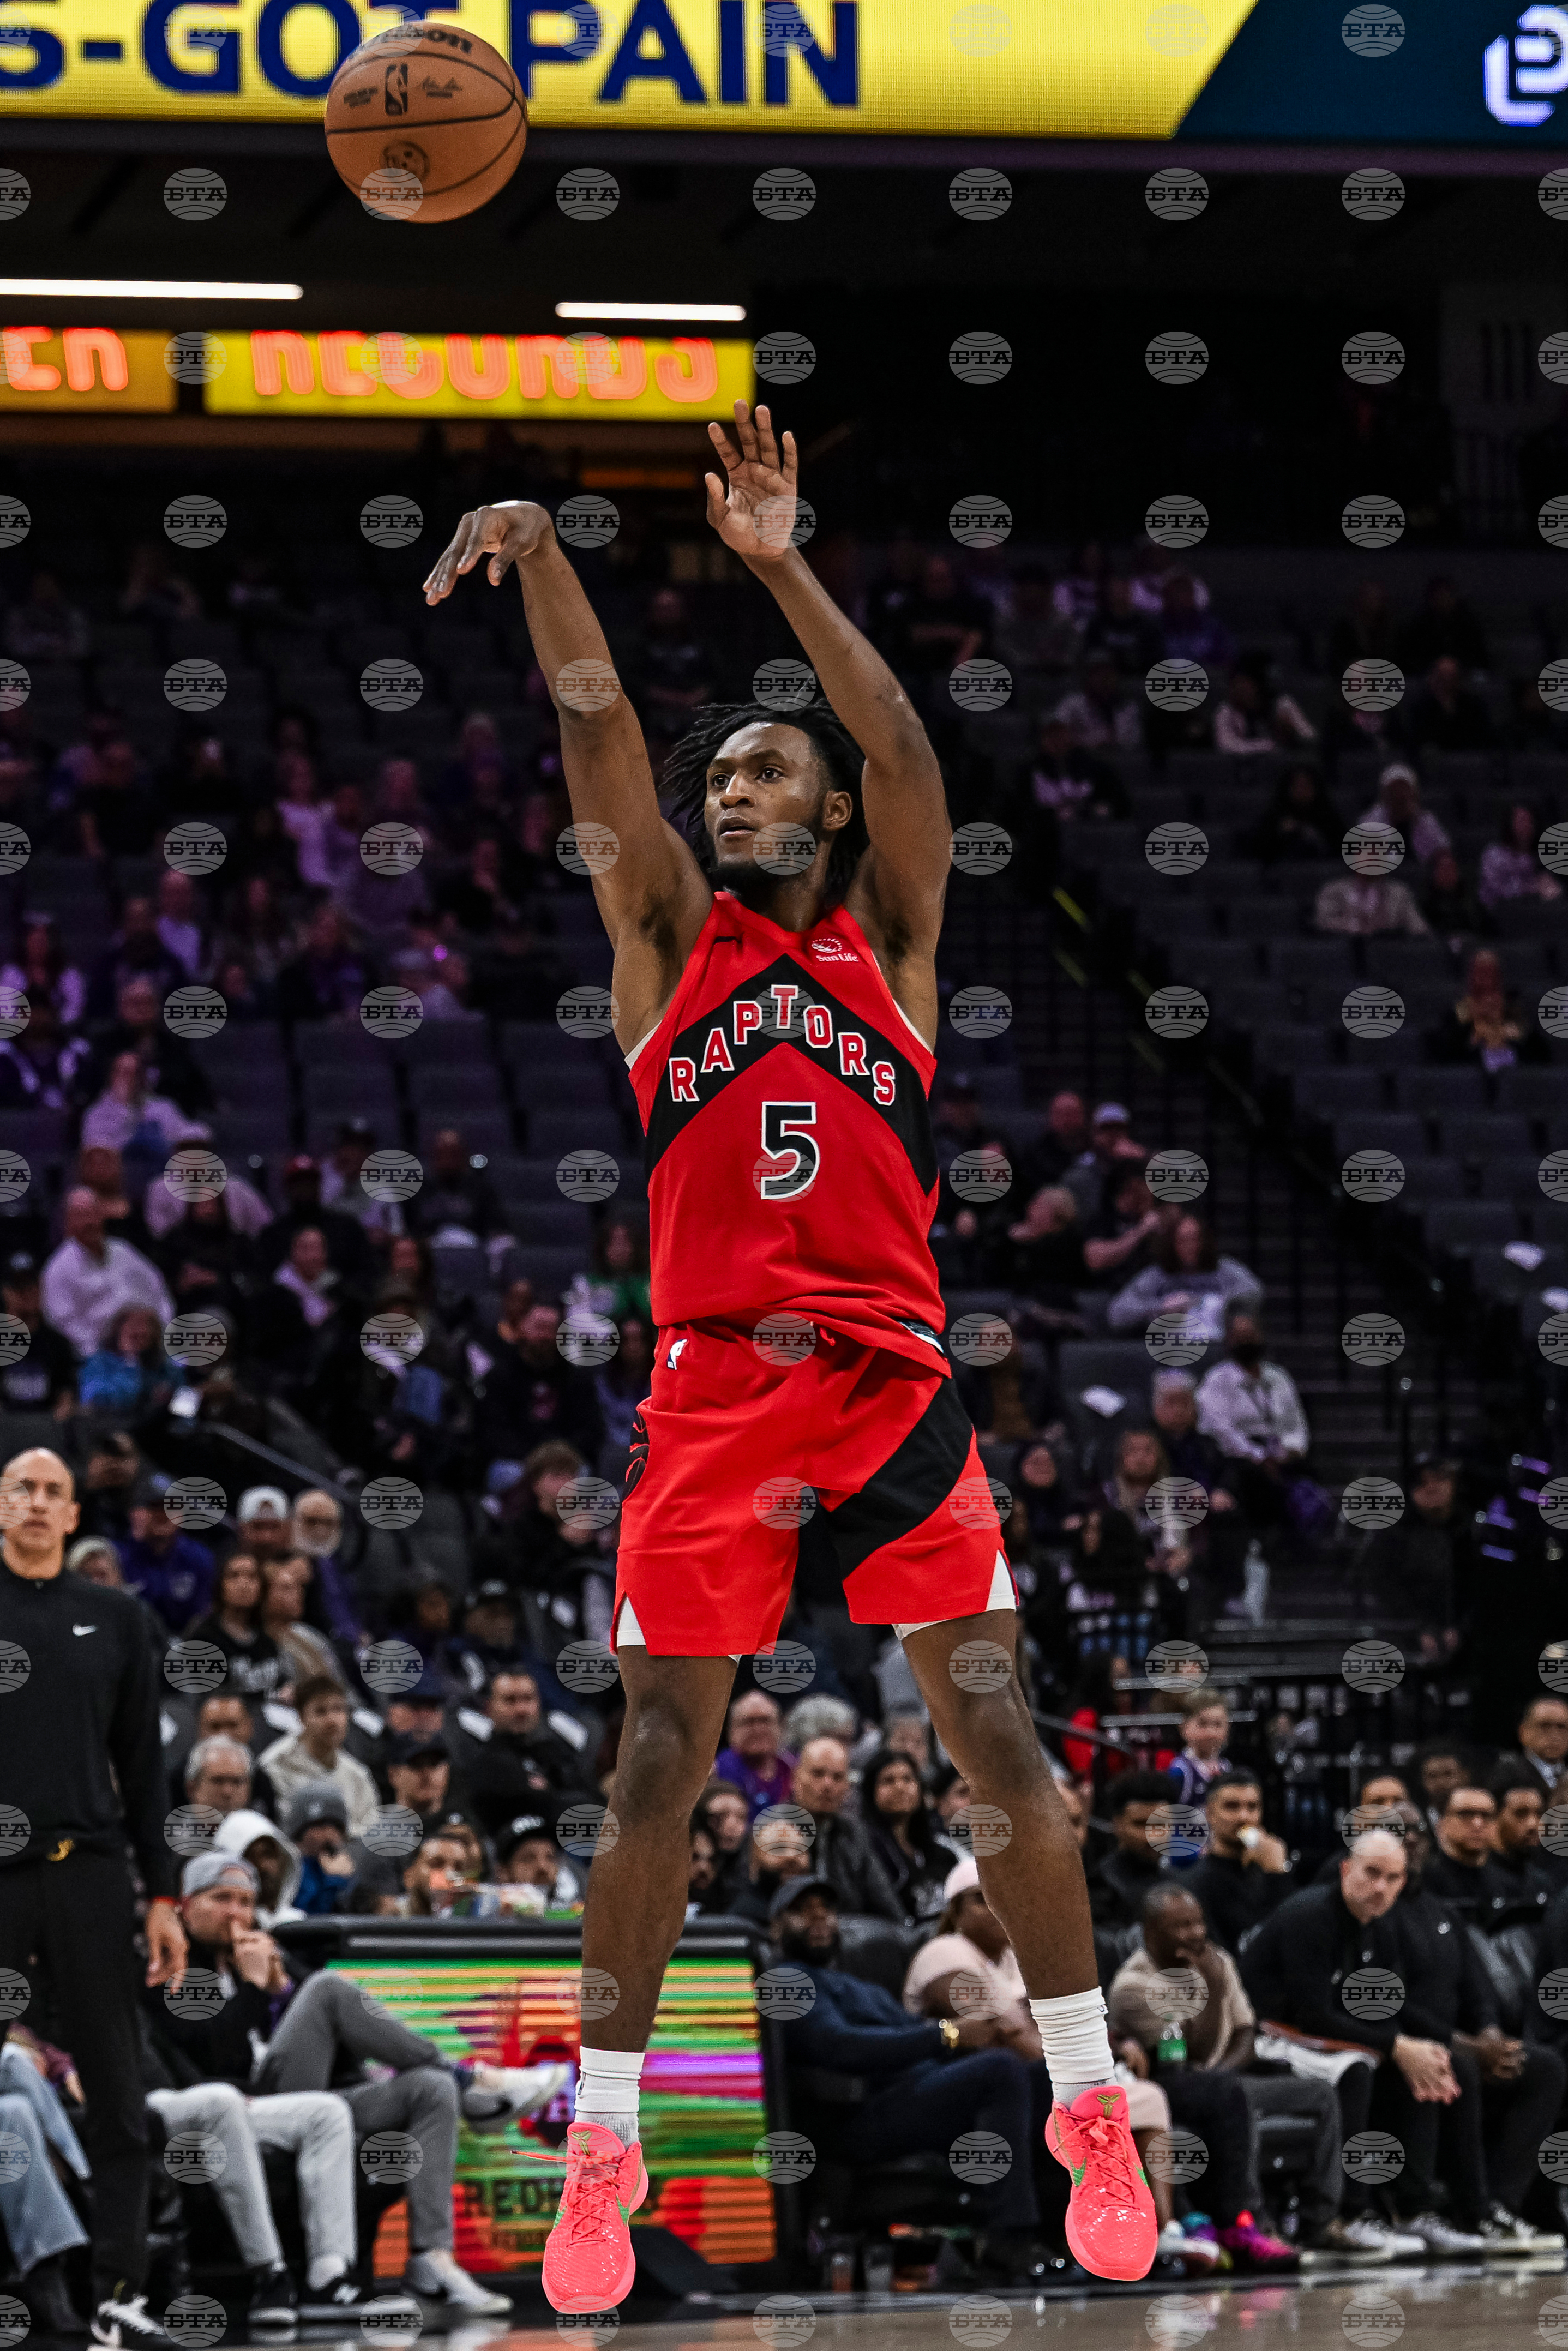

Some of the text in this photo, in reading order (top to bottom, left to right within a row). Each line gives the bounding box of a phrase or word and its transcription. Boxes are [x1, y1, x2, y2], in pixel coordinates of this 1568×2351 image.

[508, 0, 858, 106] PAIN
[838, 953, 858, 961] Life
[669, 984, 896, 1106] RAPTORS
[760, 1101, 820, 1200] 5
